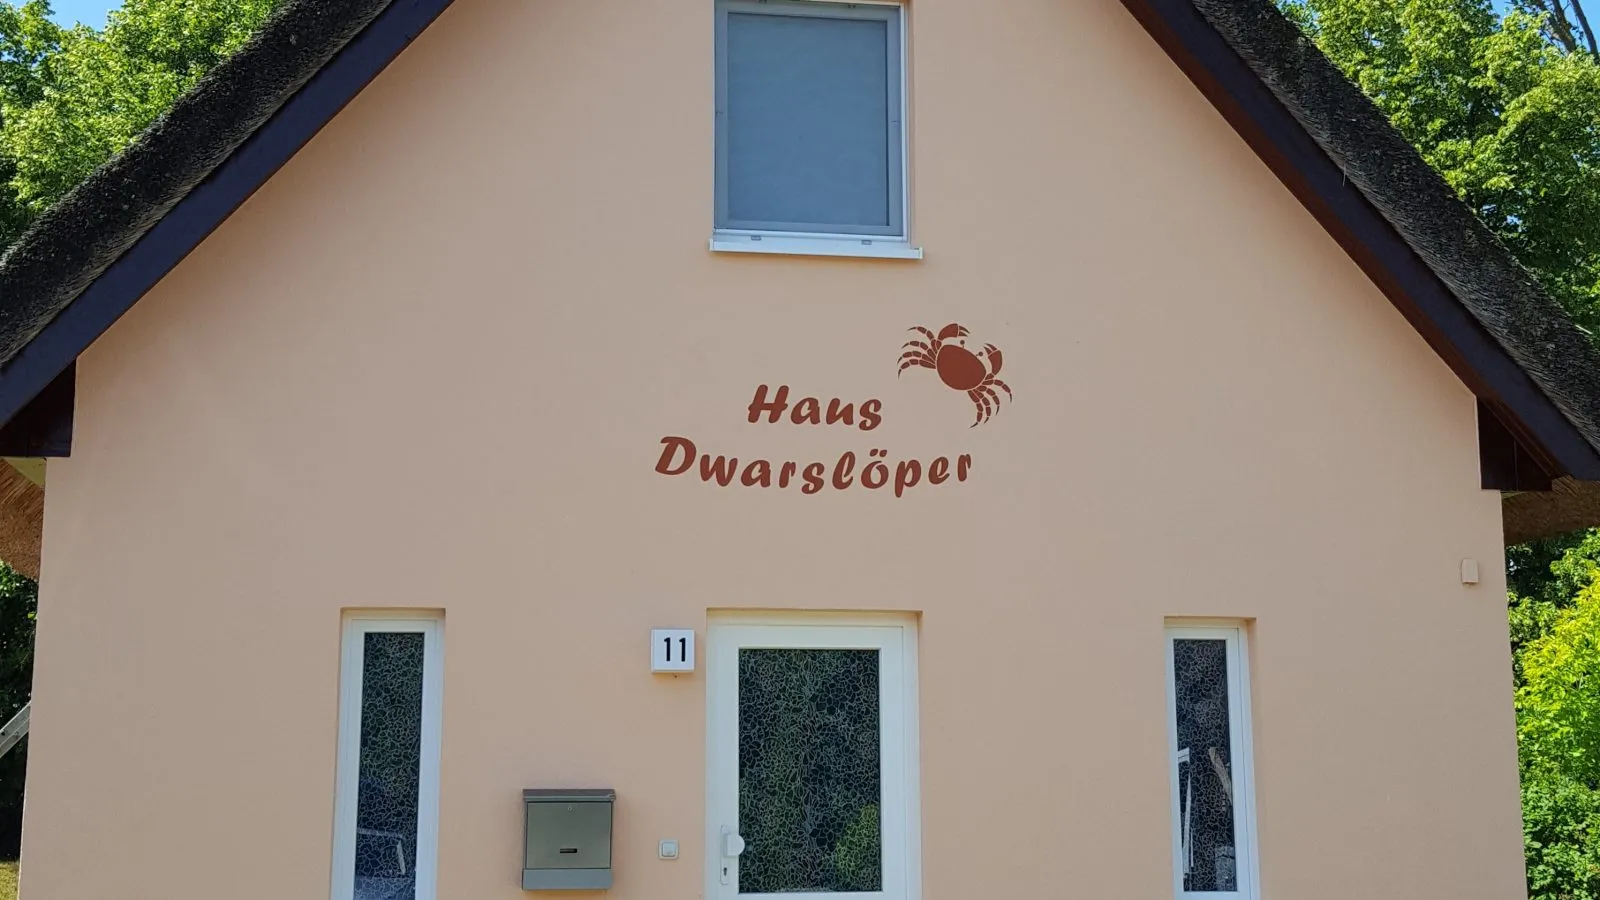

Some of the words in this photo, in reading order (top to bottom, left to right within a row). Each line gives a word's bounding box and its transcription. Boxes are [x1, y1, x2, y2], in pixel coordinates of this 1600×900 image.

[747, 384, 882, 430] Haus
[655, 436, 972, 498] Dwarslöper
[663, 637, 686, 662] 11
